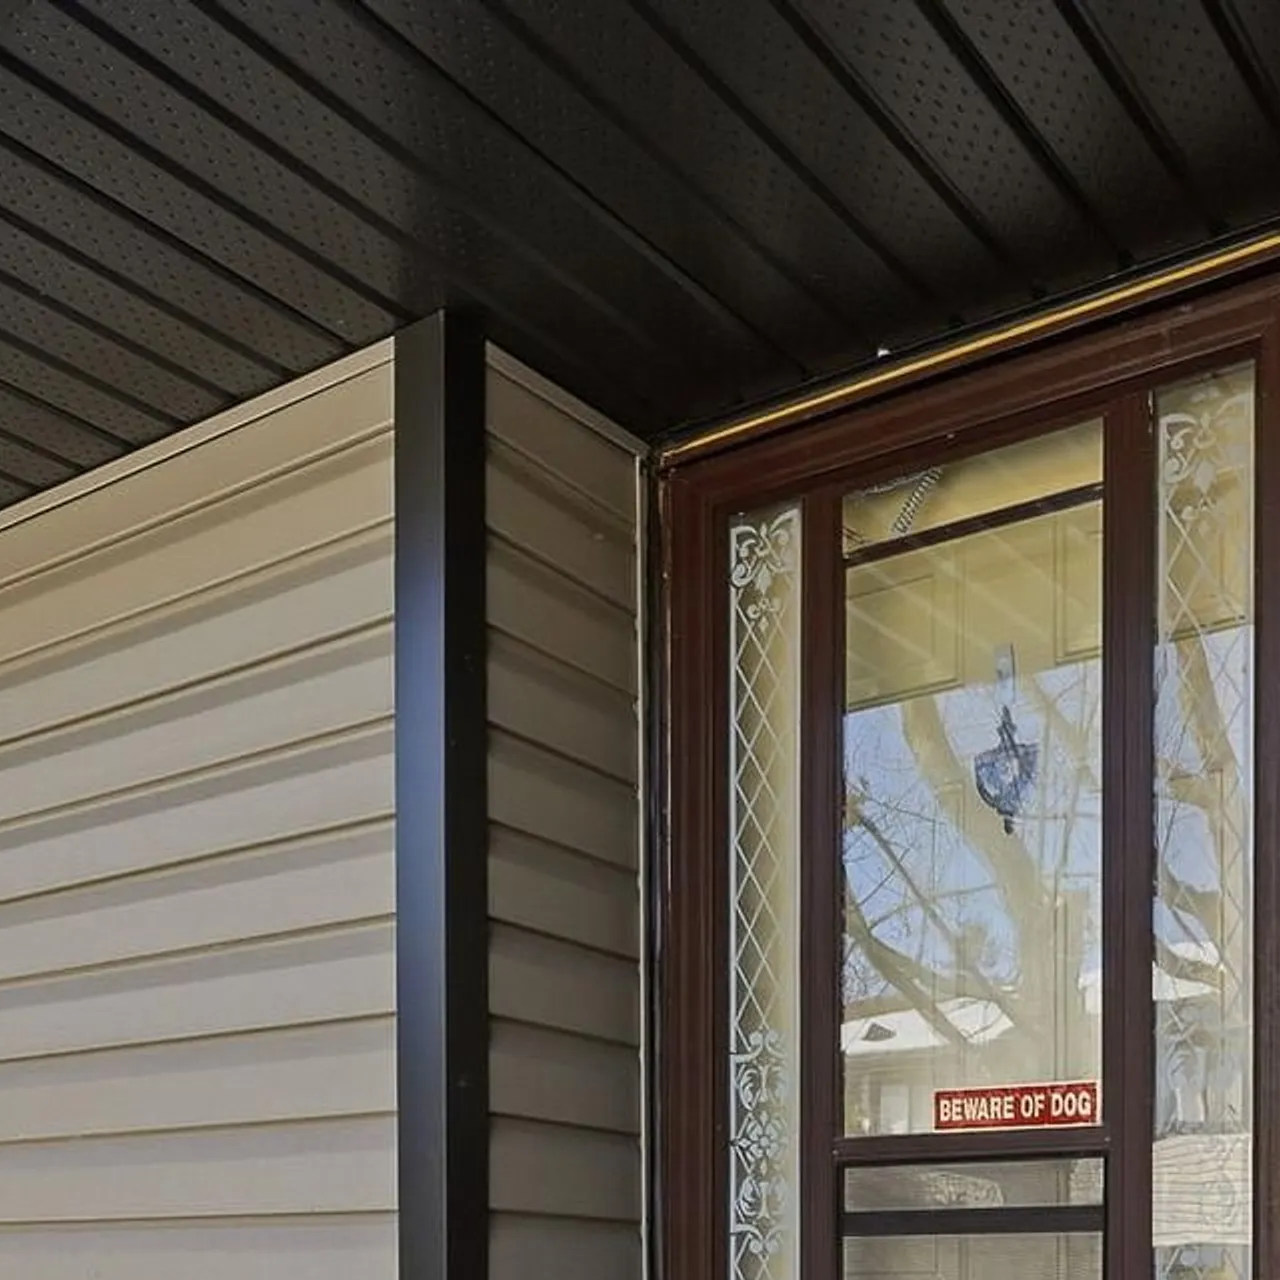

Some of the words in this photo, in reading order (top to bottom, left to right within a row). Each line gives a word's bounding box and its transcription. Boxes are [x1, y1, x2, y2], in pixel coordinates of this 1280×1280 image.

[939, 1096, 1015, 1122] BEWARE
[1020, 1093, 1045, 1118] OF
[1051, 1090, 1091, 1116] DOG
